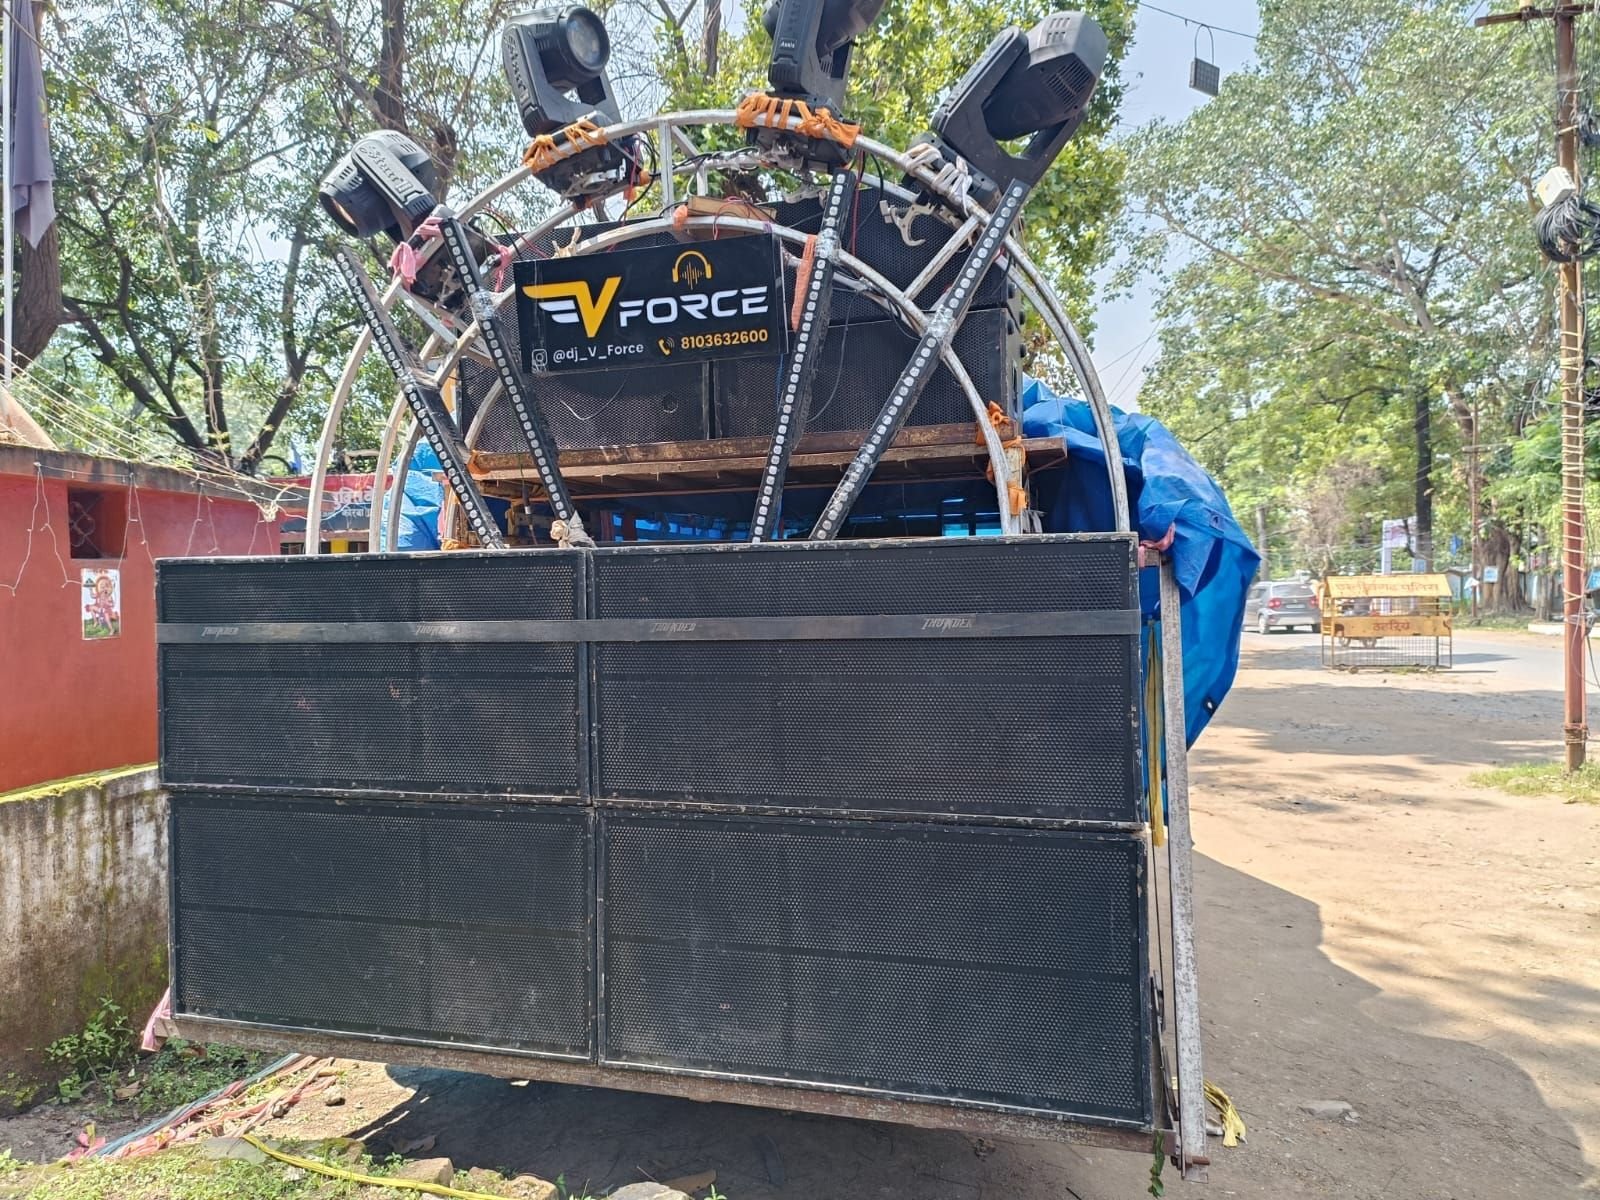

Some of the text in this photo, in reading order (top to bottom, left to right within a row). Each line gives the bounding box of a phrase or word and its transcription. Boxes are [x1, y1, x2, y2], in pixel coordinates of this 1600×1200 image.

[618, 286, 769, 328] FORCE
[680, 328, 769, 350] 8103632600
[552, 344, 644, 363] @dj_V_Force
